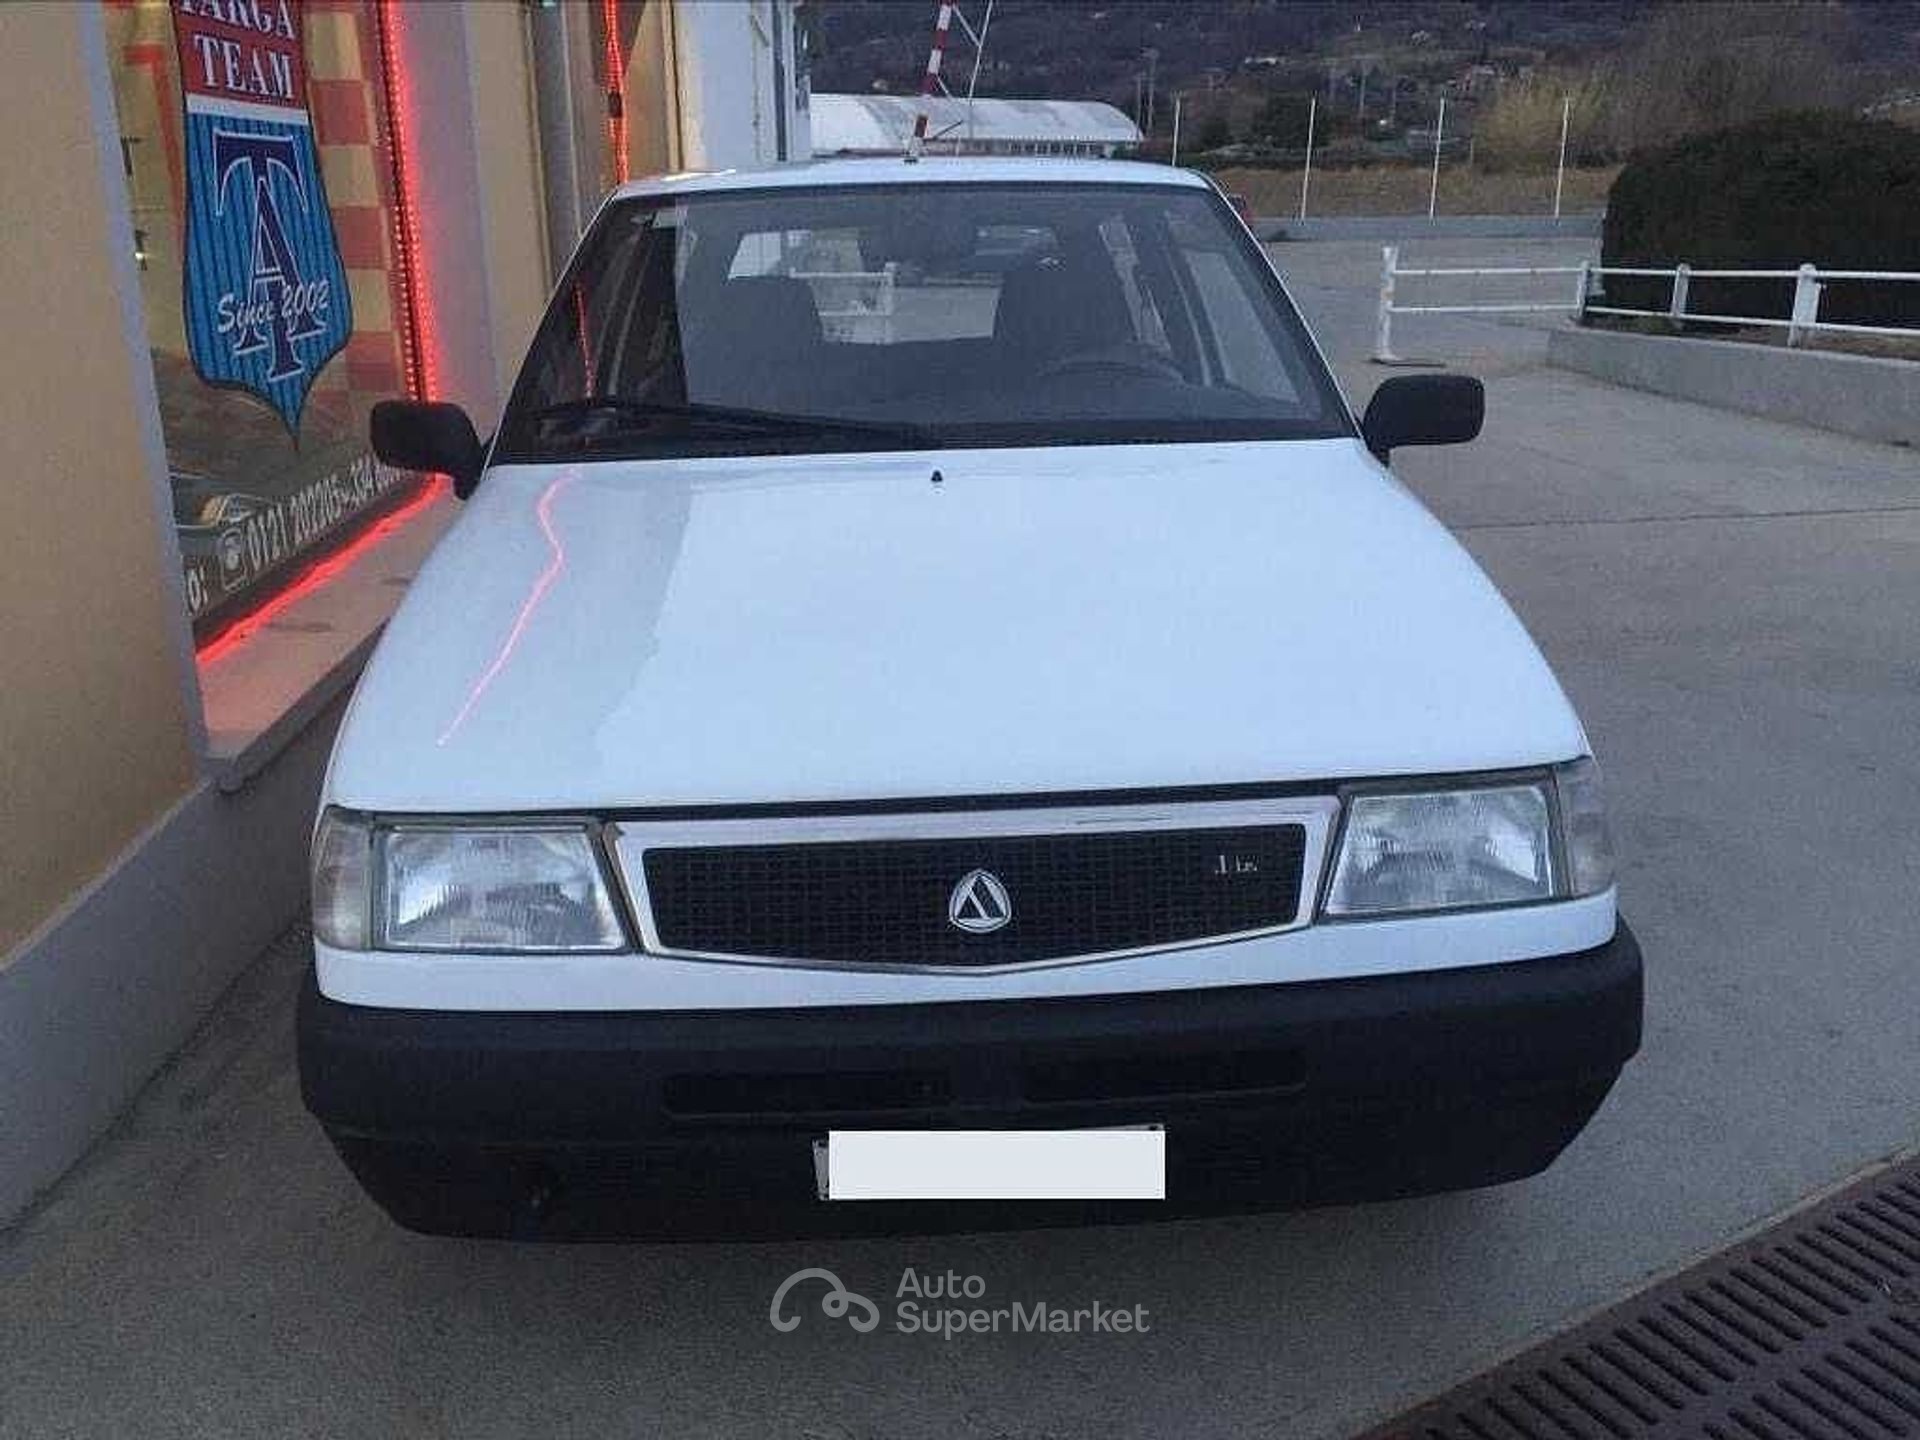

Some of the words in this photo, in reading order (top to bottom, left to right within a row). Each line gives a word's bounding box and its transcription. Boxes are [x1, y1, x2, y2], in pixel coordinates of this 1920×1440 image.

[182, 0, 295, 39] RGA
[193, 34, 293, 98] TEAM
[218, 293, 276, 333] Since
[281, 280, 329, 318] 2002
[247, 503, 289, 571] 0121
